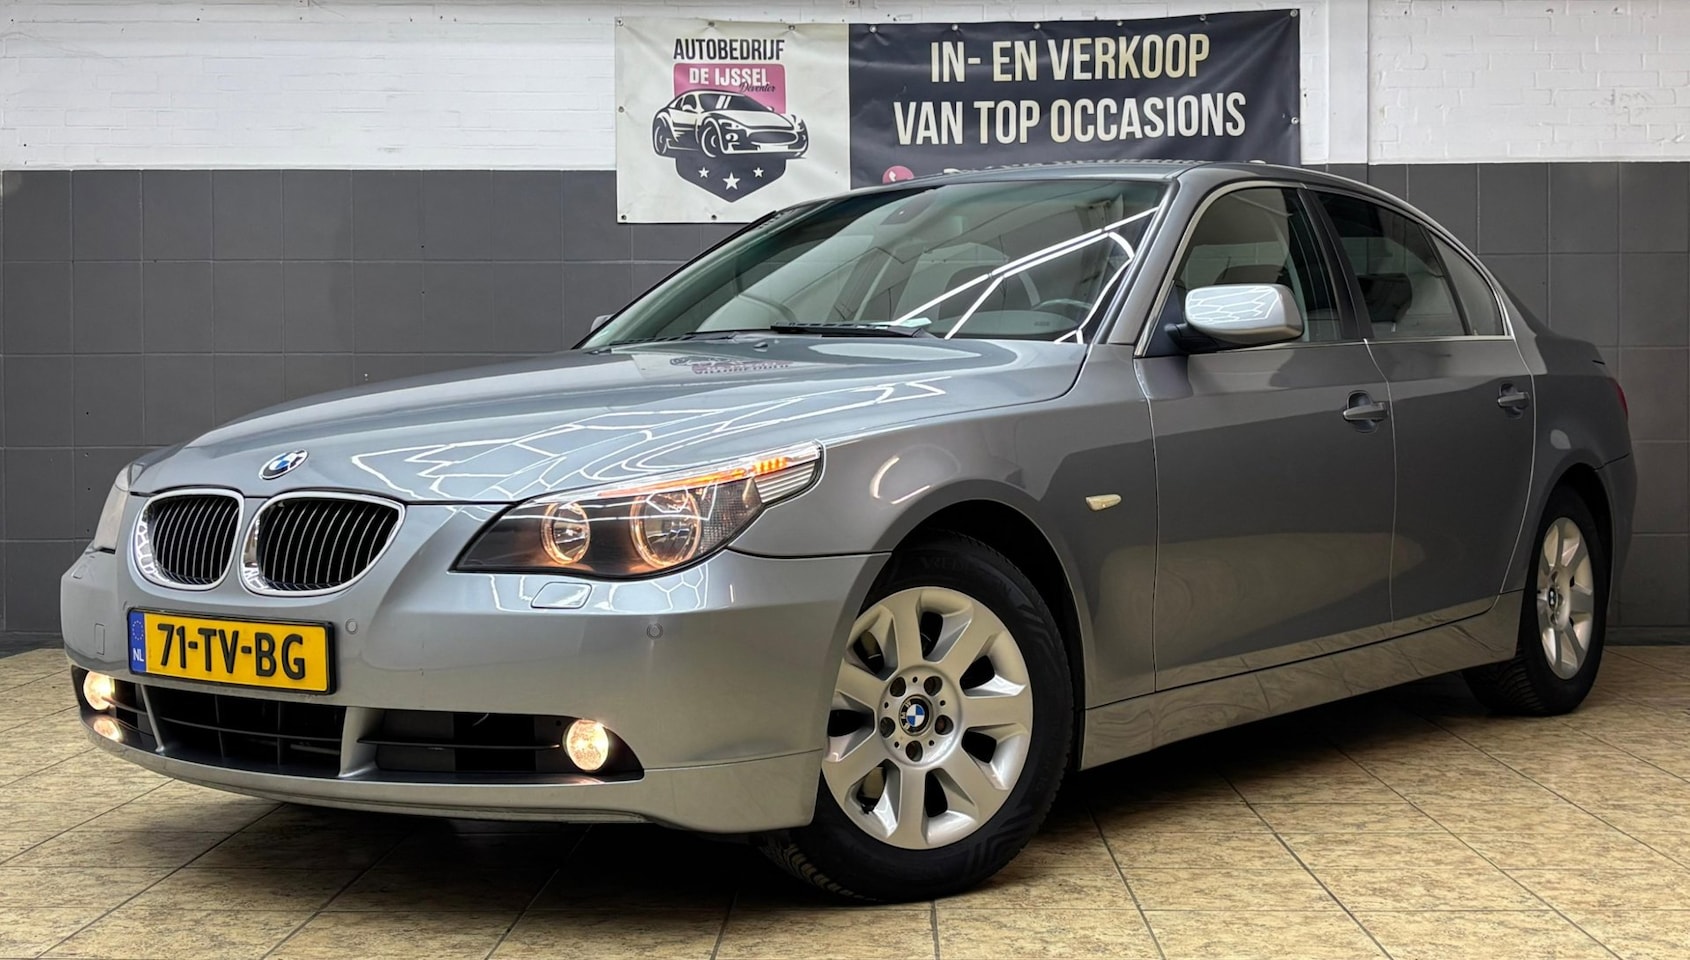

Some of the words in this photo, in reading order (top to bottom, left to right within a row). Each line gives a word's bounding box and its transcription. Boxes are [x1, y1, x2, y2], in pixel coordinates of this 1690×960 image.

[673, 38, 785, 60] AUTOBEDRIJF
[931, 41, 981, 82] IN-
[993, 40, 1037, 81] EN
[1047, 33, 1210, 80] VERKOOP
[689, 67, 709, 84] DE
[715, 68, 770, 86] IJSSEL
[739, 81, 776, 93] Deventer
[893, 101, 963, 144] VAN
[973, 100, 1040, 144] TOP
[1050, 92, 1246, 143] OCCASIONS
[132, 647, 145, 662] NL
[157, 623, 306, 680] 71-TV-BG
